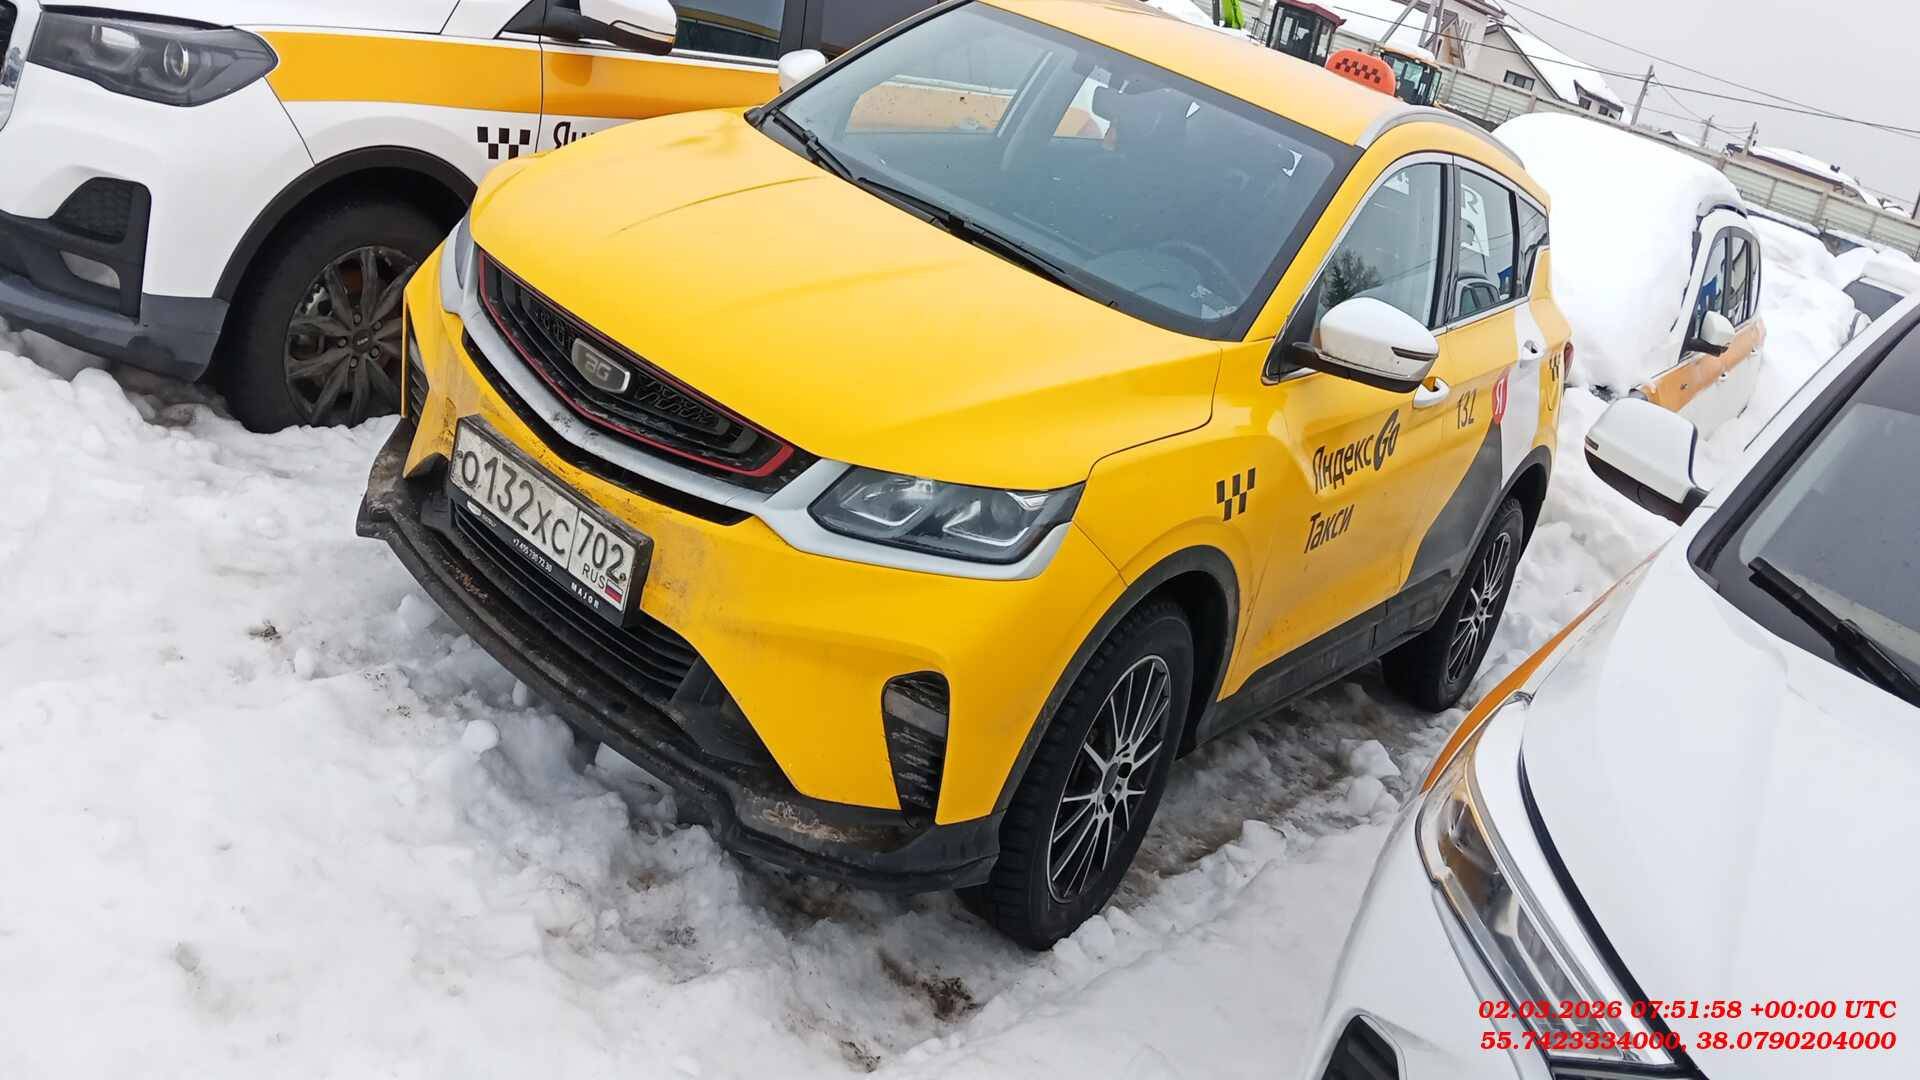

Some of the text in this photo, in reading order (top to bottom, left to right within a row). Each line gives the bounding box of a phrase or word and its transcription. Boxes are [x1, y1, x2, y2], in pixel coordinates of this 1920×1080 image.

[1456, 389, 1477, 430] 132
[1312, 434, 1374, 494] Яндекс
[1304, 504, 1355, 554] Такси
[570, 581, 600, 609] MAJOR
[582, 563, 607, 590] RUS
